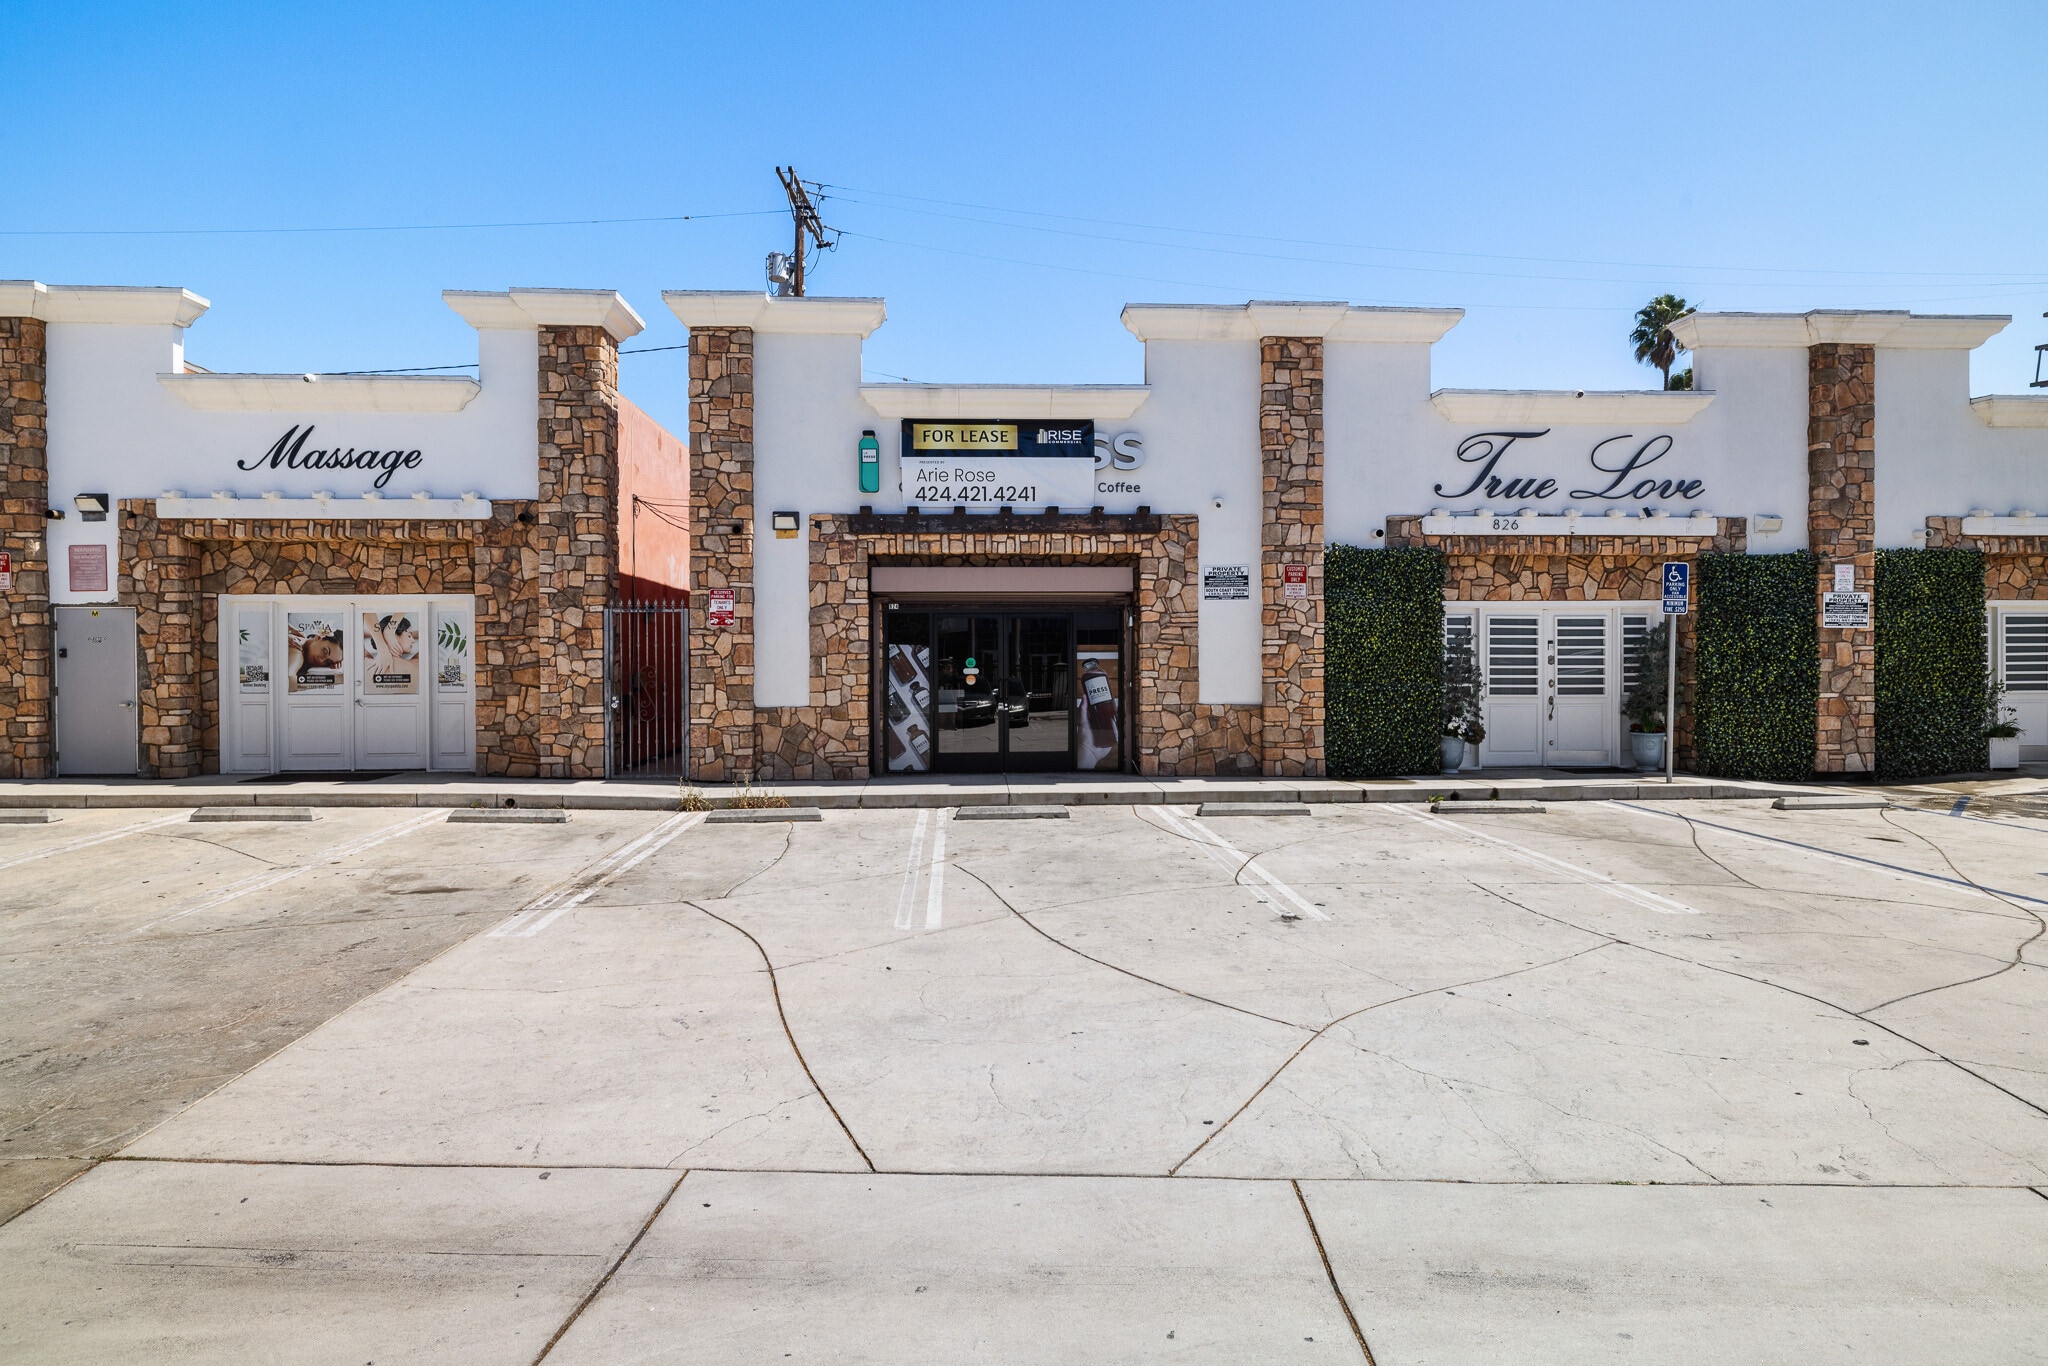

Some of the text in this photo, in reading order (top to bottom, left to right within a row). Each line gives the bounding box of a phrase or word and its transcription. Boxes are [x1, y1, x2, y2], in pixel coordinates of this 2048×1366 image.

[923, 430, 1009, 443] FOR LEASE
[1048, 430, 1082, 440] RISE
[237, 424, 423, 489] Massage
[1434, 428, 1706, 500] True Love
[916, 467, 996, 482] Arie Rose
[915, 486, 1036, 502] 424.421.4241
[1097, 482, 1141, 493] Coffee
[1493, 518, 1519, 530] 826
[1088, 687, 1108, 696] PRESS
